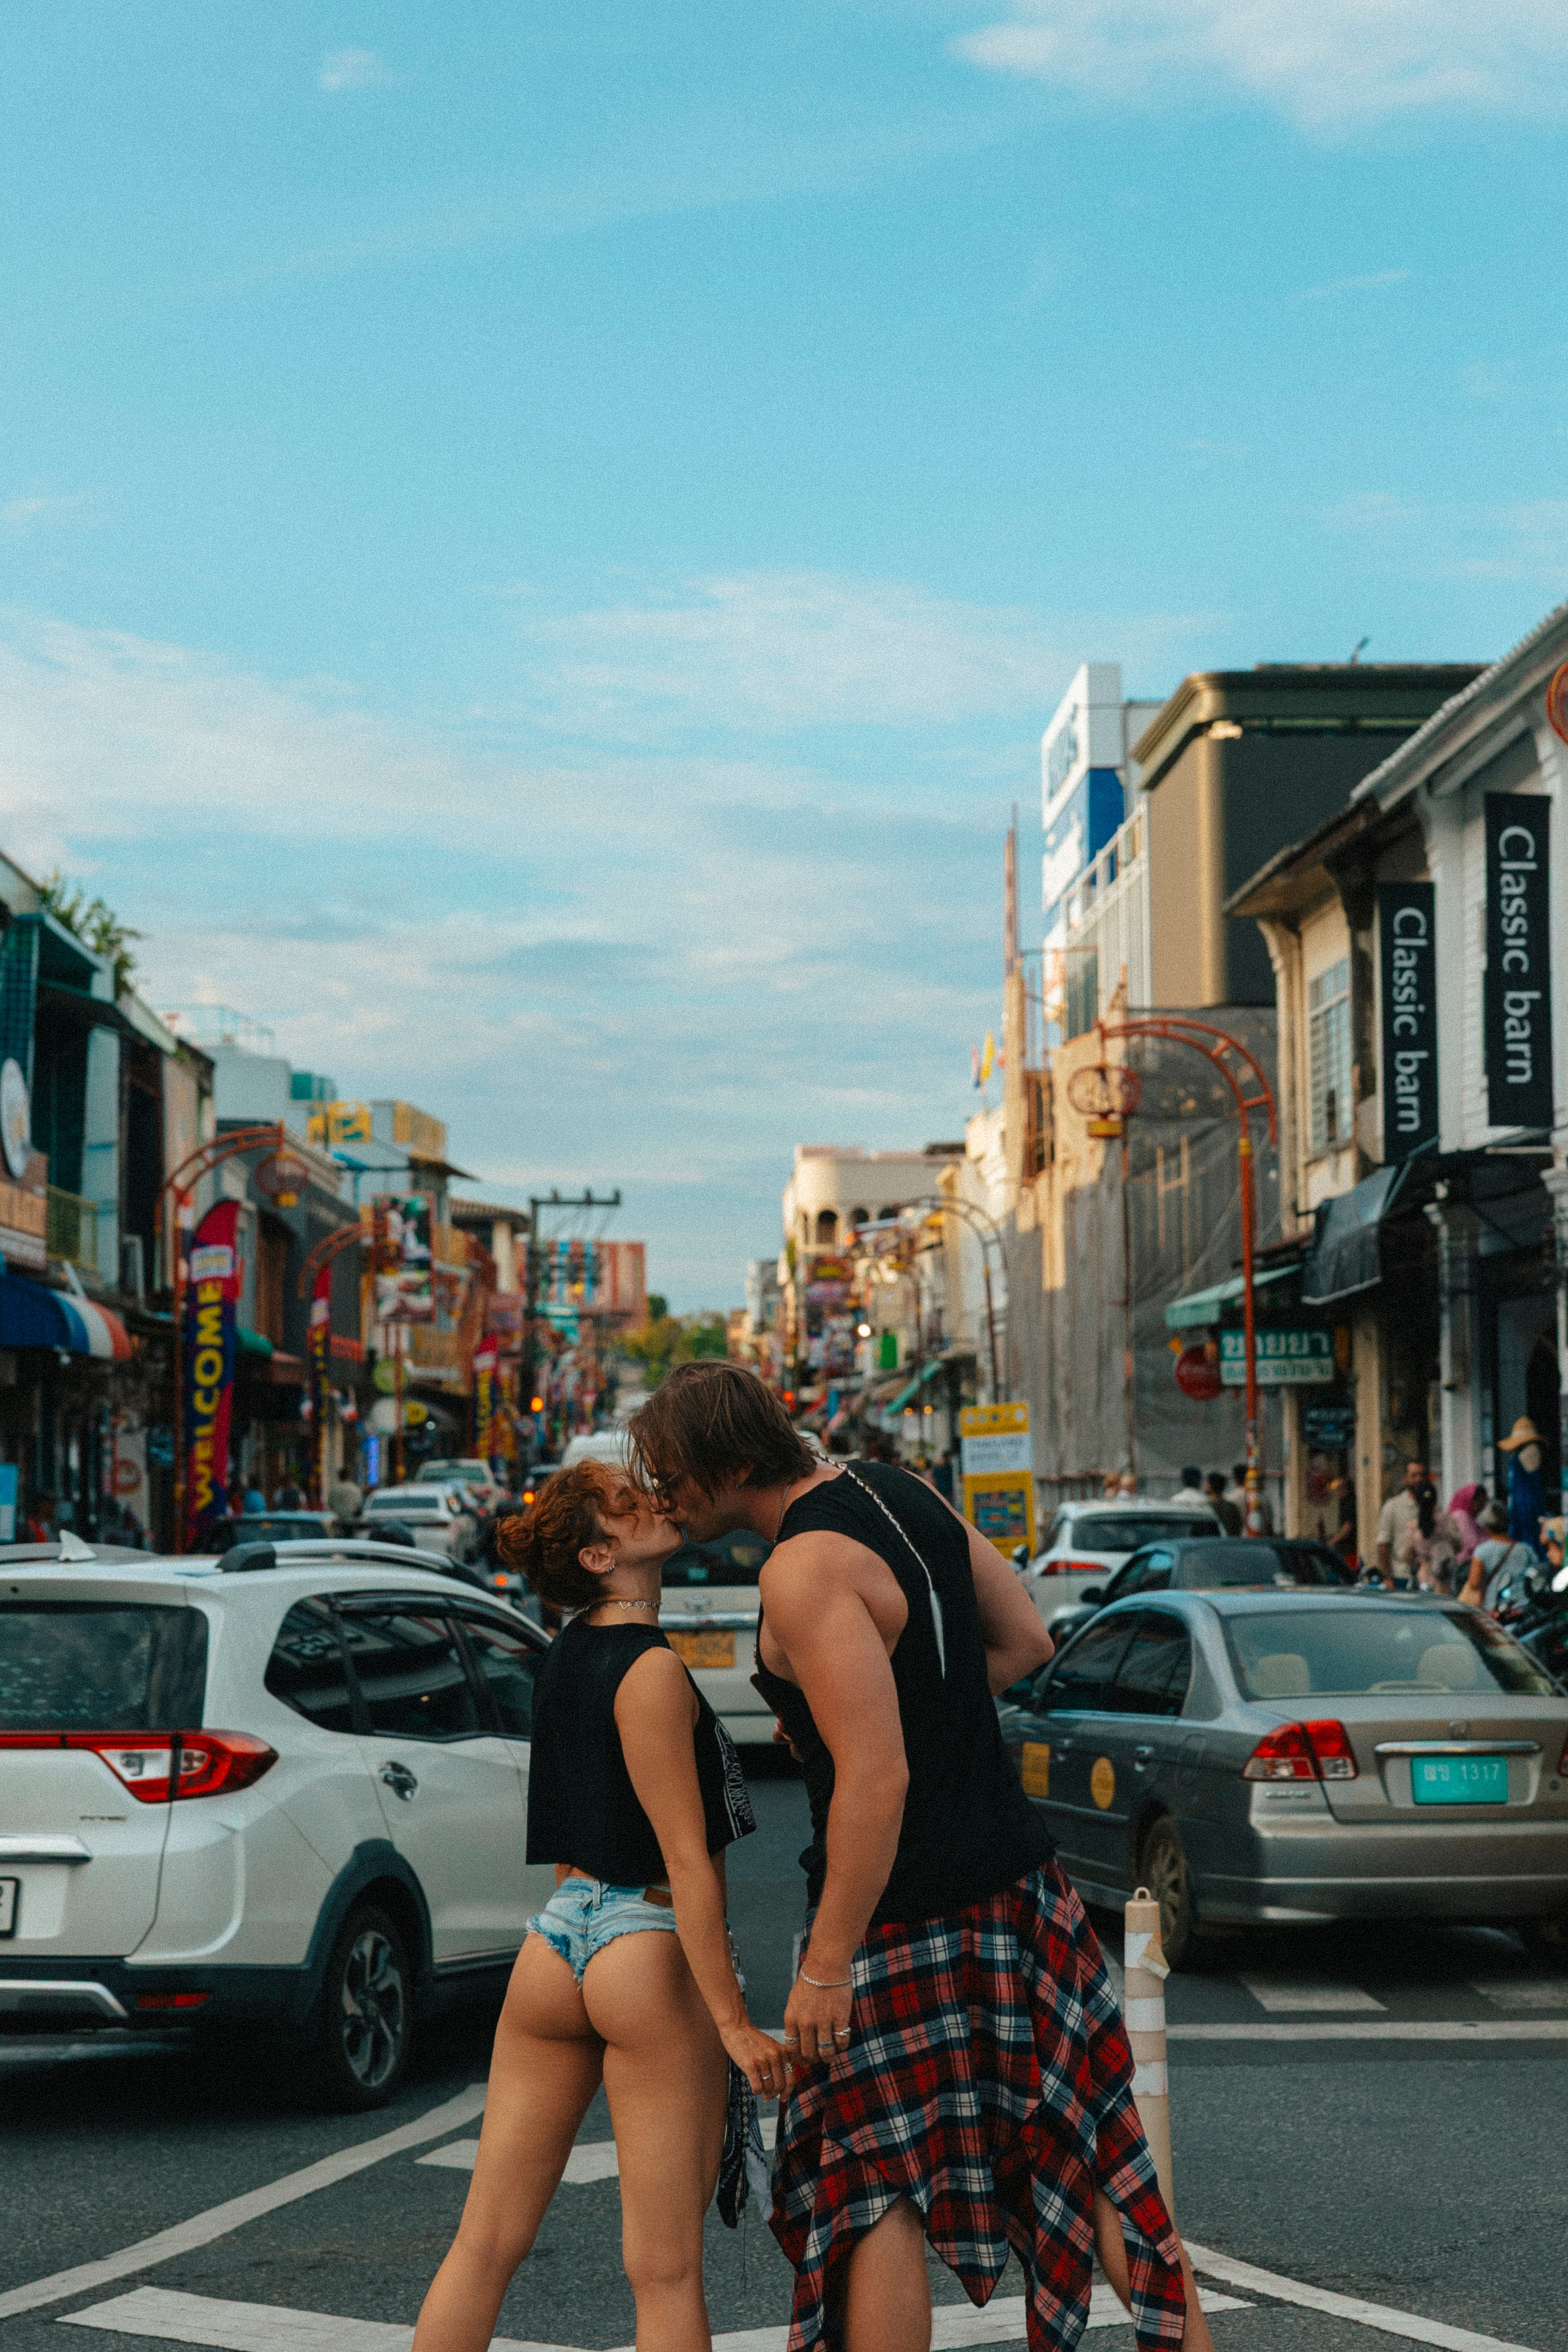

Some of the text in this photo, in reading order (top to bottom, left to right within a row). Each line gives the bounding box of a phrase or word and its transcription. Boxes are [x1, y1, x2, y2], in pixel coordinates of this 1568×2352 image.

[1392, 907, 1429, 1133] Classic barn
[1499, 825, 1542, 1084] Classic barn
[194, 1281, 223, 1509] WELCOME
